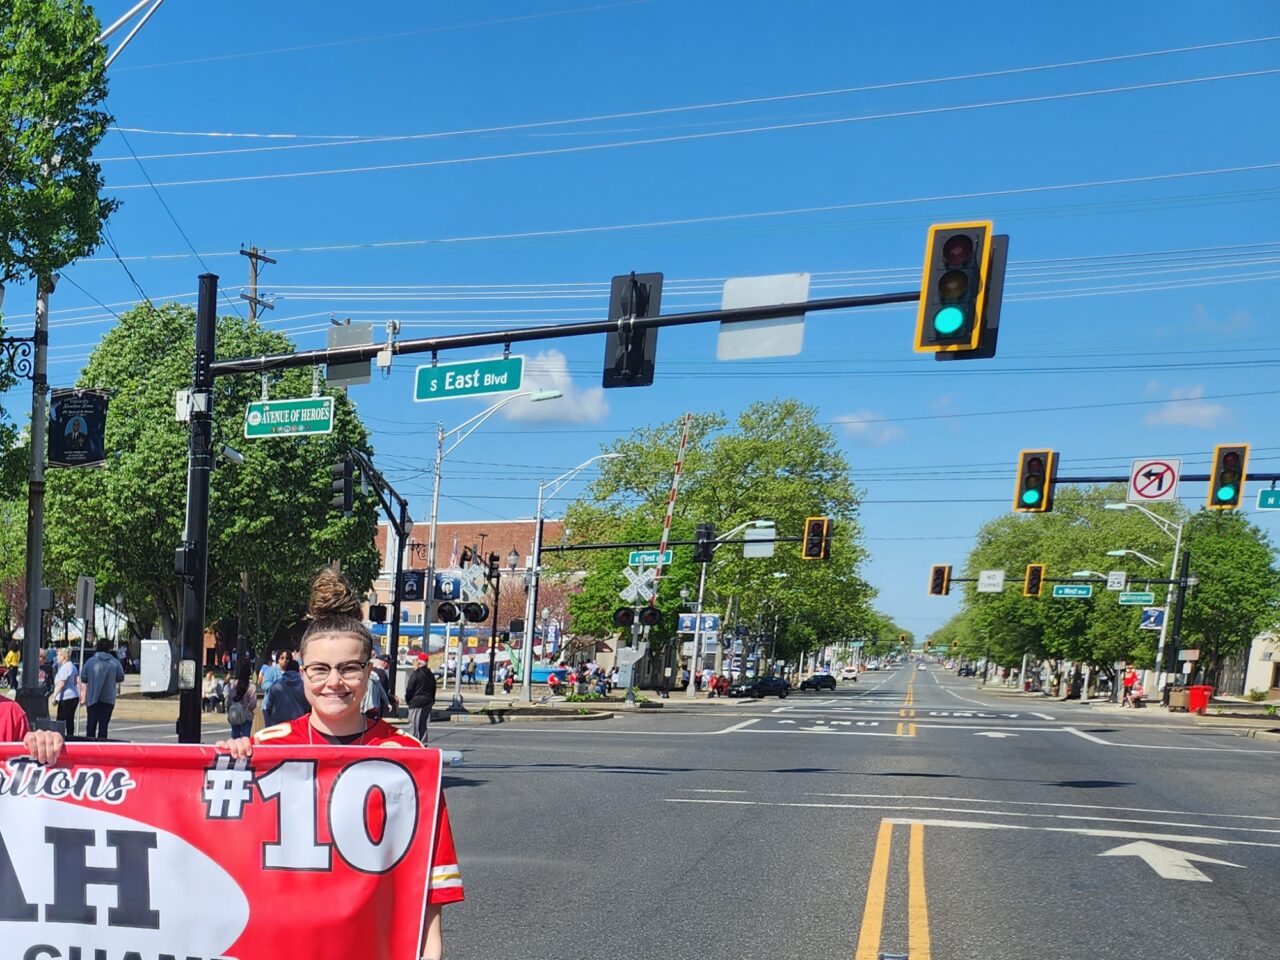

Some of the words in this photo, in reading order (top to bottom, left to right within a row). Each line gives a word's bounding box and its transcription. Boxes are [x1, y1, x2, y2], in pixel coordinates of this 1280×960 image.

[430, 380, 437, 391] S
[444, 371, 480, 390] East
[484, 372, 508, 386] Blvd
[261, 410, 290, 424] AVENUE
[290, 409, 301, 422] OF
[301, 407, 330, 421] HEROES
[1267, 497, 1275, 505] N
[1108, 580, 1122, 588] 25
[929, 710, 1020, 718] ONLY
[202, 754, 420, 875] #10
